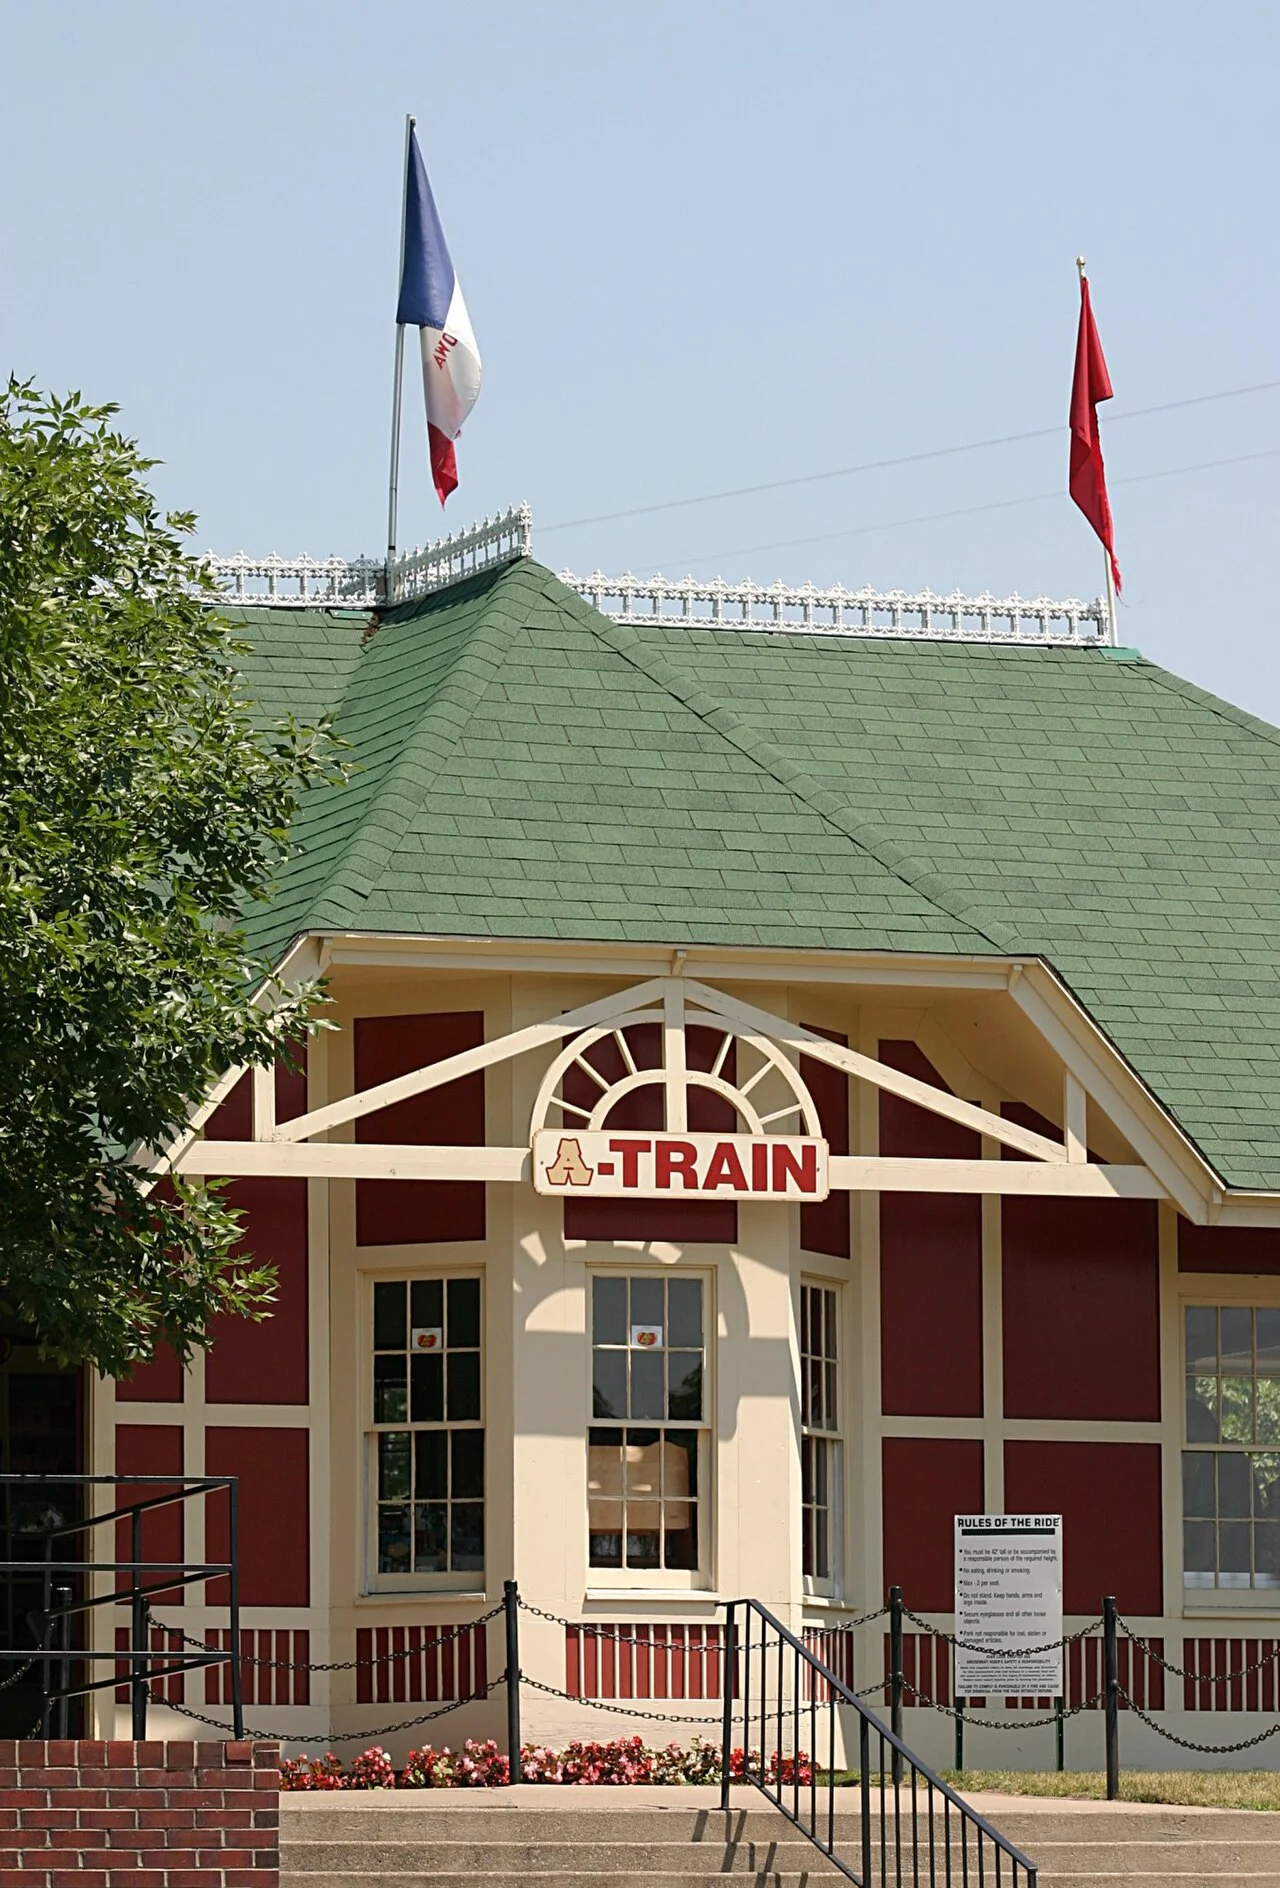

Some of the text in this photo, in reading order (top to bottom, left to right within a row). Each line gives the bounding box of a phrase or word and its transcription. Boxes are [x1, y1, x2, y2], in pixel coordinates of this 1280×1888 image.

[545, 1138, 817, 1193] A-TRAIN
[958, 1518, 1059, 1527] RULES OF THE RIDE
